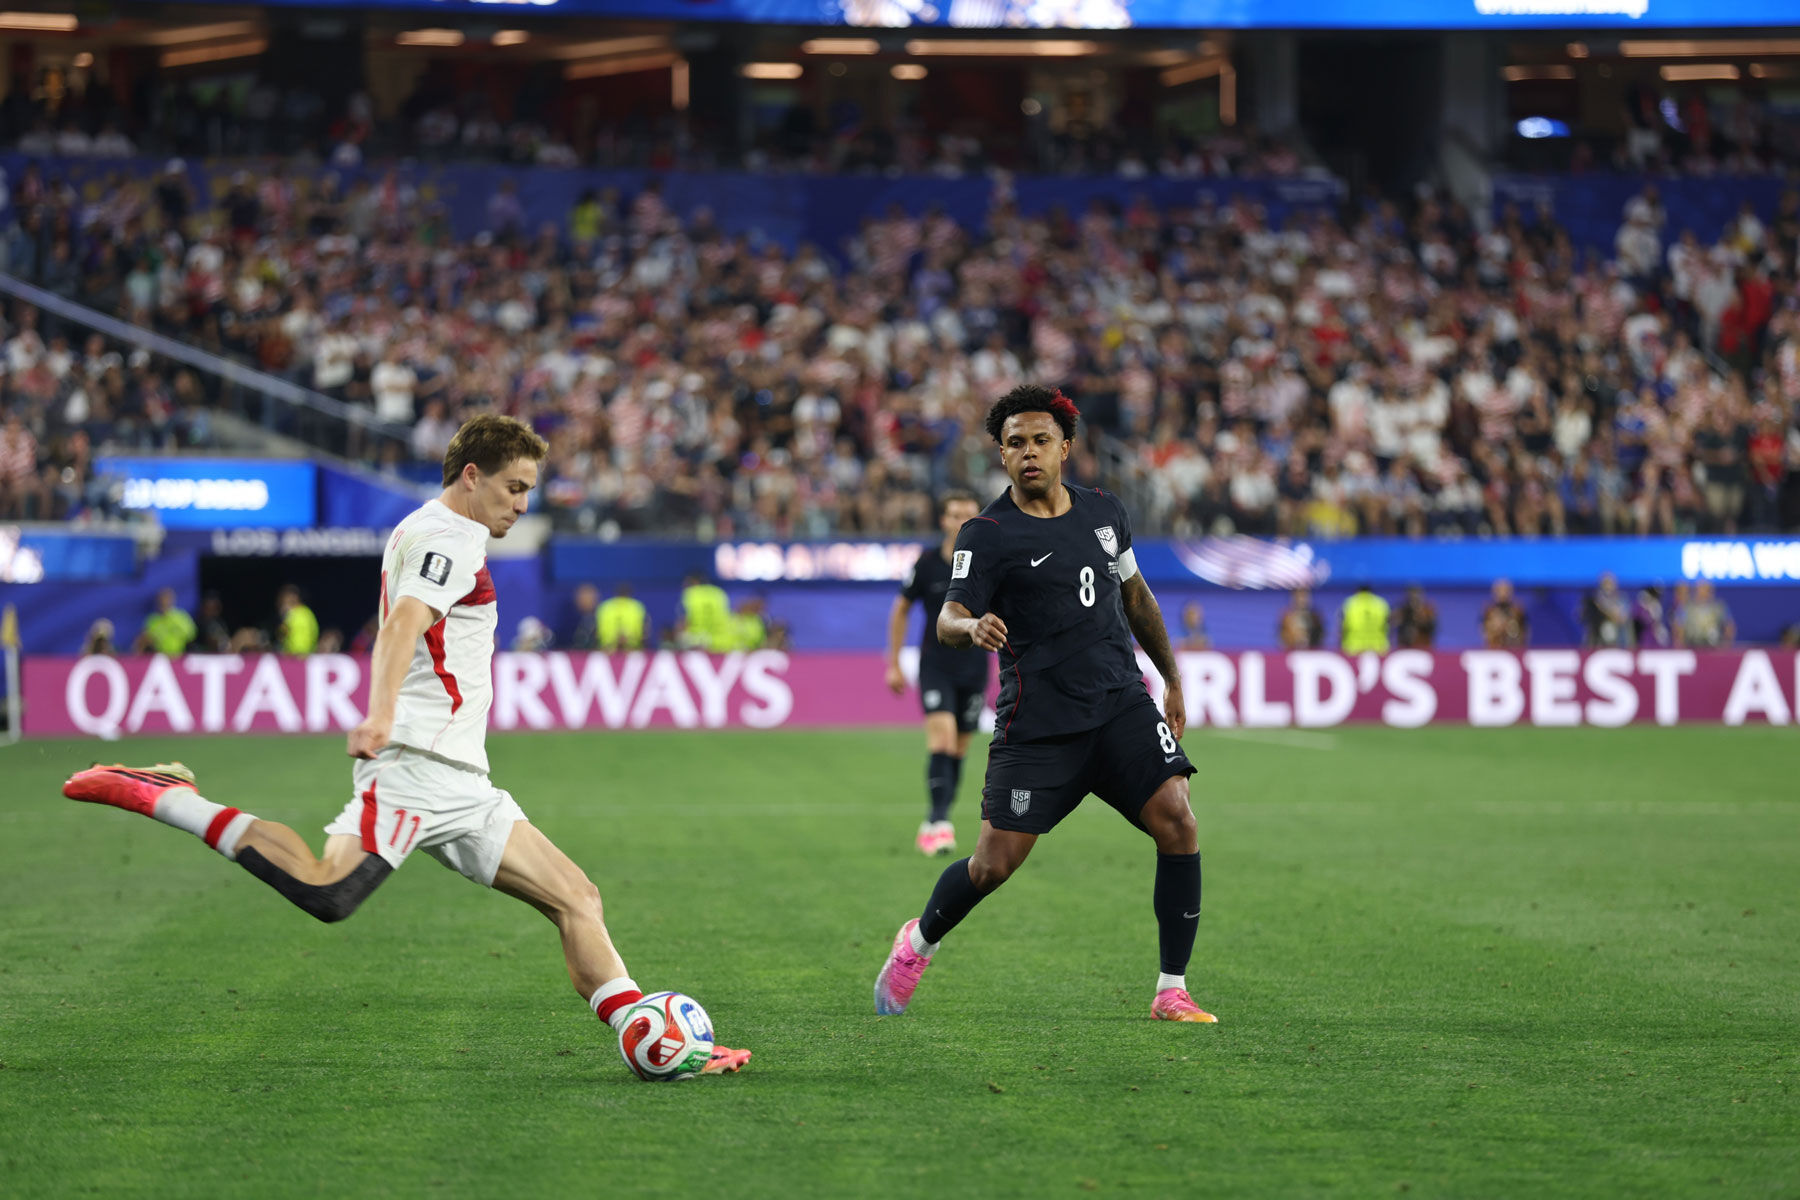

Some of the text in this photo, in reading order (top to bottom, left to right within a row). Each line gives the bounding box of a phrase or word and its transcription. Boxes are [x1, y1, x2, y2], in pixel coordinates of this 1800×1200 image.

[1079, 566, 1096, 607] 8
[66, 648, 793, 740] QATAR RWAYS
[1132, 649, 1800, 728] RLD'S BEST A
[1156, 721, 1176, 754] 8
[1013, 791, 1029, 802] USA
[390, 809, 421, 854] 11
